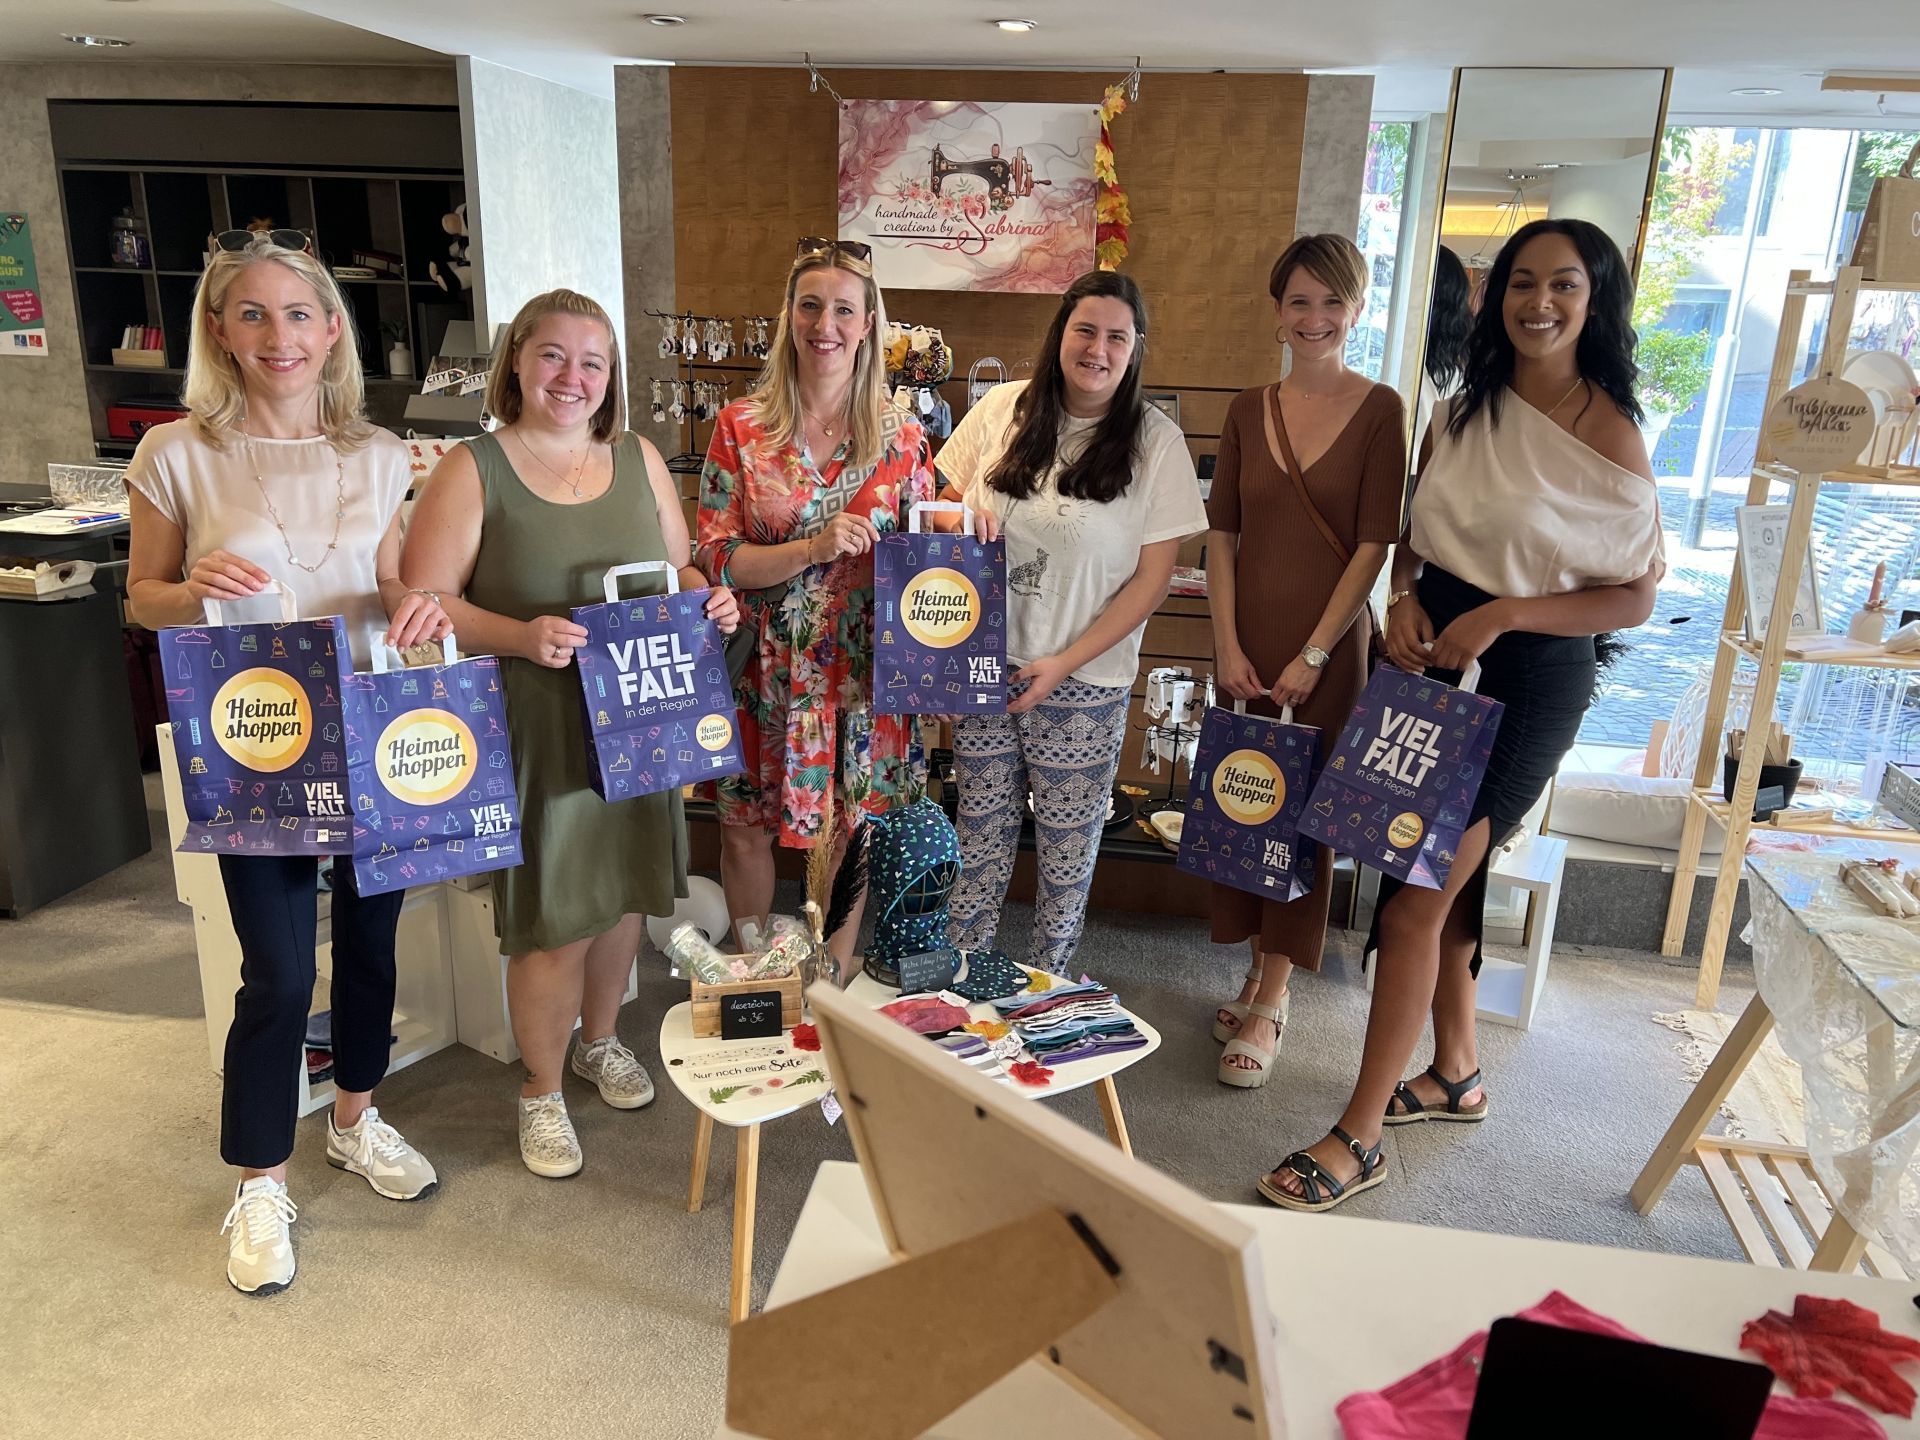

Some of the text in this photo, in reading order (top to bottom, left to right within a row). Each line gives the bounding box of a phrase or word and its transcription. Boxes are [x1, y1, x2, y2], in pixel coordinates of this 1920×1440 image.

[875, 204, 938, 220] handmade
[883, 220, 954, 236] creations by
[957, 202, 1048, 256] Sabrina
[426, 372, 446, 384] CITY
[463, 374, 483, 385] CITY
[911, 589, 969, 607] Heimat
[909, 606, 971, 626] shoppen
[606, 633, 693, 673] VIEL
[967, 656, 1001, 670] VIEL
[617, 662, 696, 706] FALT
[969, 670, 1002, 684] FALT
[225, 698, 298, 720] Heimat
[624, 697, 699, 719] in der Region
[225, 719, 303, 743] shoppen
[700, 722, 726, 734] Heimat
[700, 730, 728, 742] shoppen
[1380, 706, 1443, 758] VIEL
[388, 732, 460, 759] Heimat
[388, 752, 467, 779] shoppen
[1361, 737, 1438, 788] FALT
[1224, 766, 1276, 791] Heimat
[1355, 768, 1416, 799] in der Region
[303, 782, 343, 800] VIEL
[1219, 781, 1276, 805] shoppen
[306, 799, 345, 816] FALT
[470, 803, 511, 824] VIEL
[326, 815, 346, 823] Region
[474, 817, 513, 837] FALT
[1264, 838, 1291, 858] VIEL
[1262, 851, 1292, 871] FALT
[738, 1015, 747, 1023] ab
[693, 1058, 804, 1080] Nur noch eine Seite
